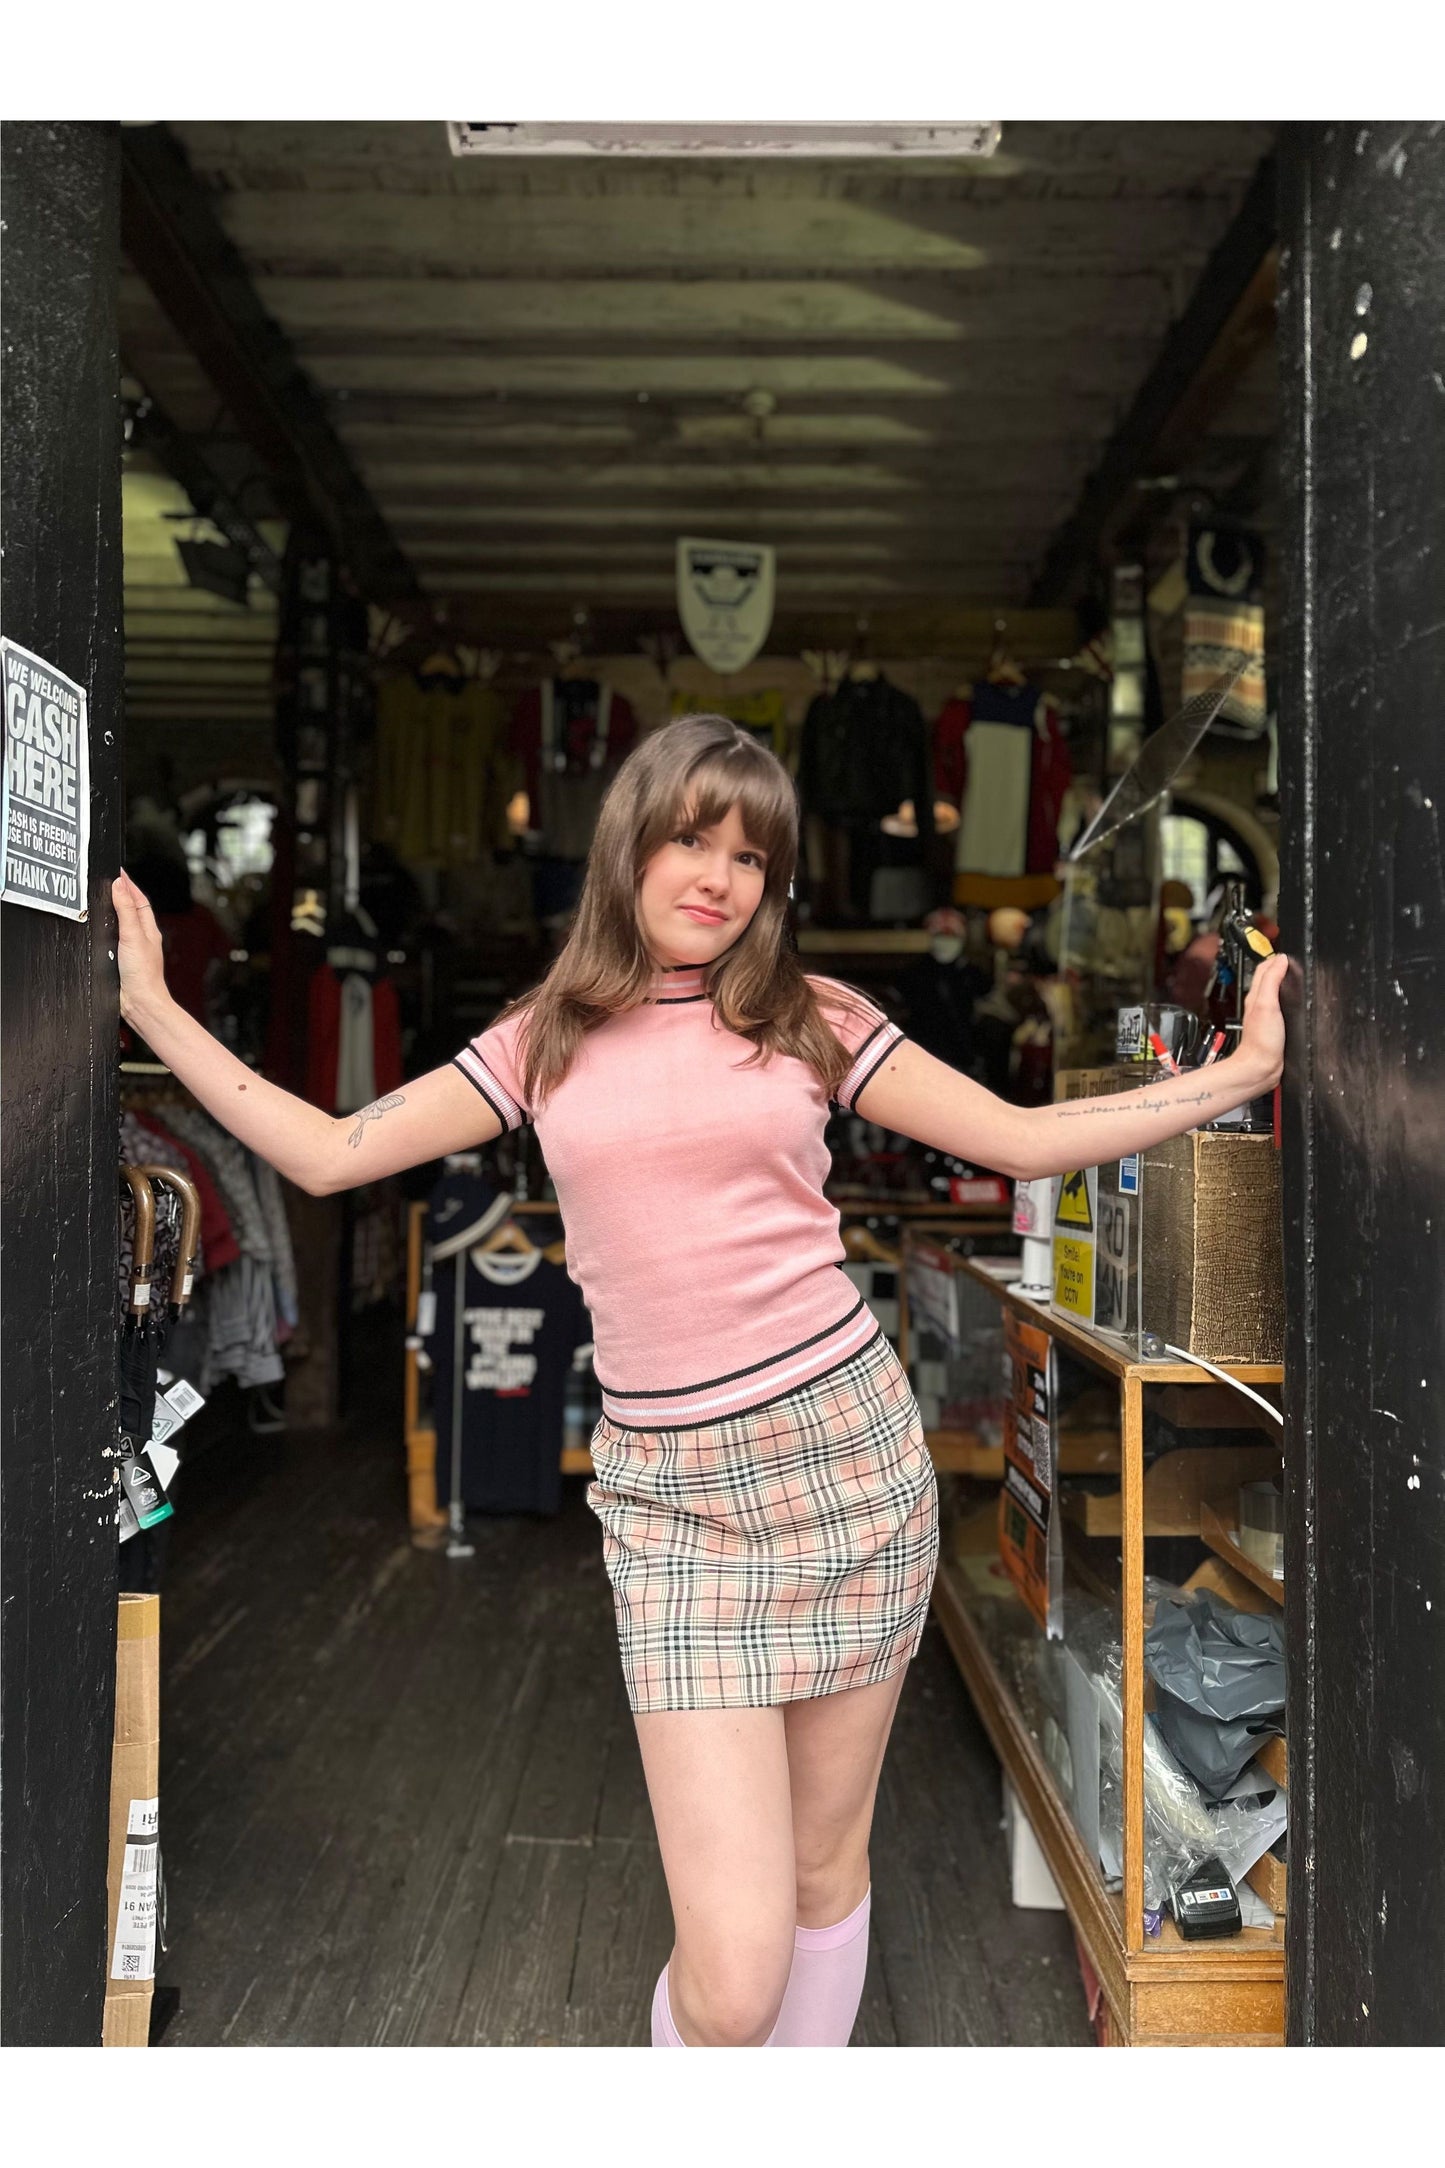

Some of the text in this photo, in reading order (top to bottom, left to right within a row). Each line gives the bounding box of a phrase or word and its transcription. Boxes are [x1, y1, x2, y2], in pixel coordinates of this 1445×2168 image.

[8, 657, 78, 717] WE WELCOME
[8, 683, 77, 768] CASH
[8, 735, 76, 819] HERE
[23, 831, 31, 848] IT
[33, 835, 43, 853] OR
[45, 839, 67, 861] LOSE
[29, 816, 37, 834] IS
[39, 820, 76, 849] FREEDOM
[6, 856, 77, 901] THANK YOU
[1064, 1286, 1079, 1305] CCTV
[124, 1901, 136, 1912] 91
